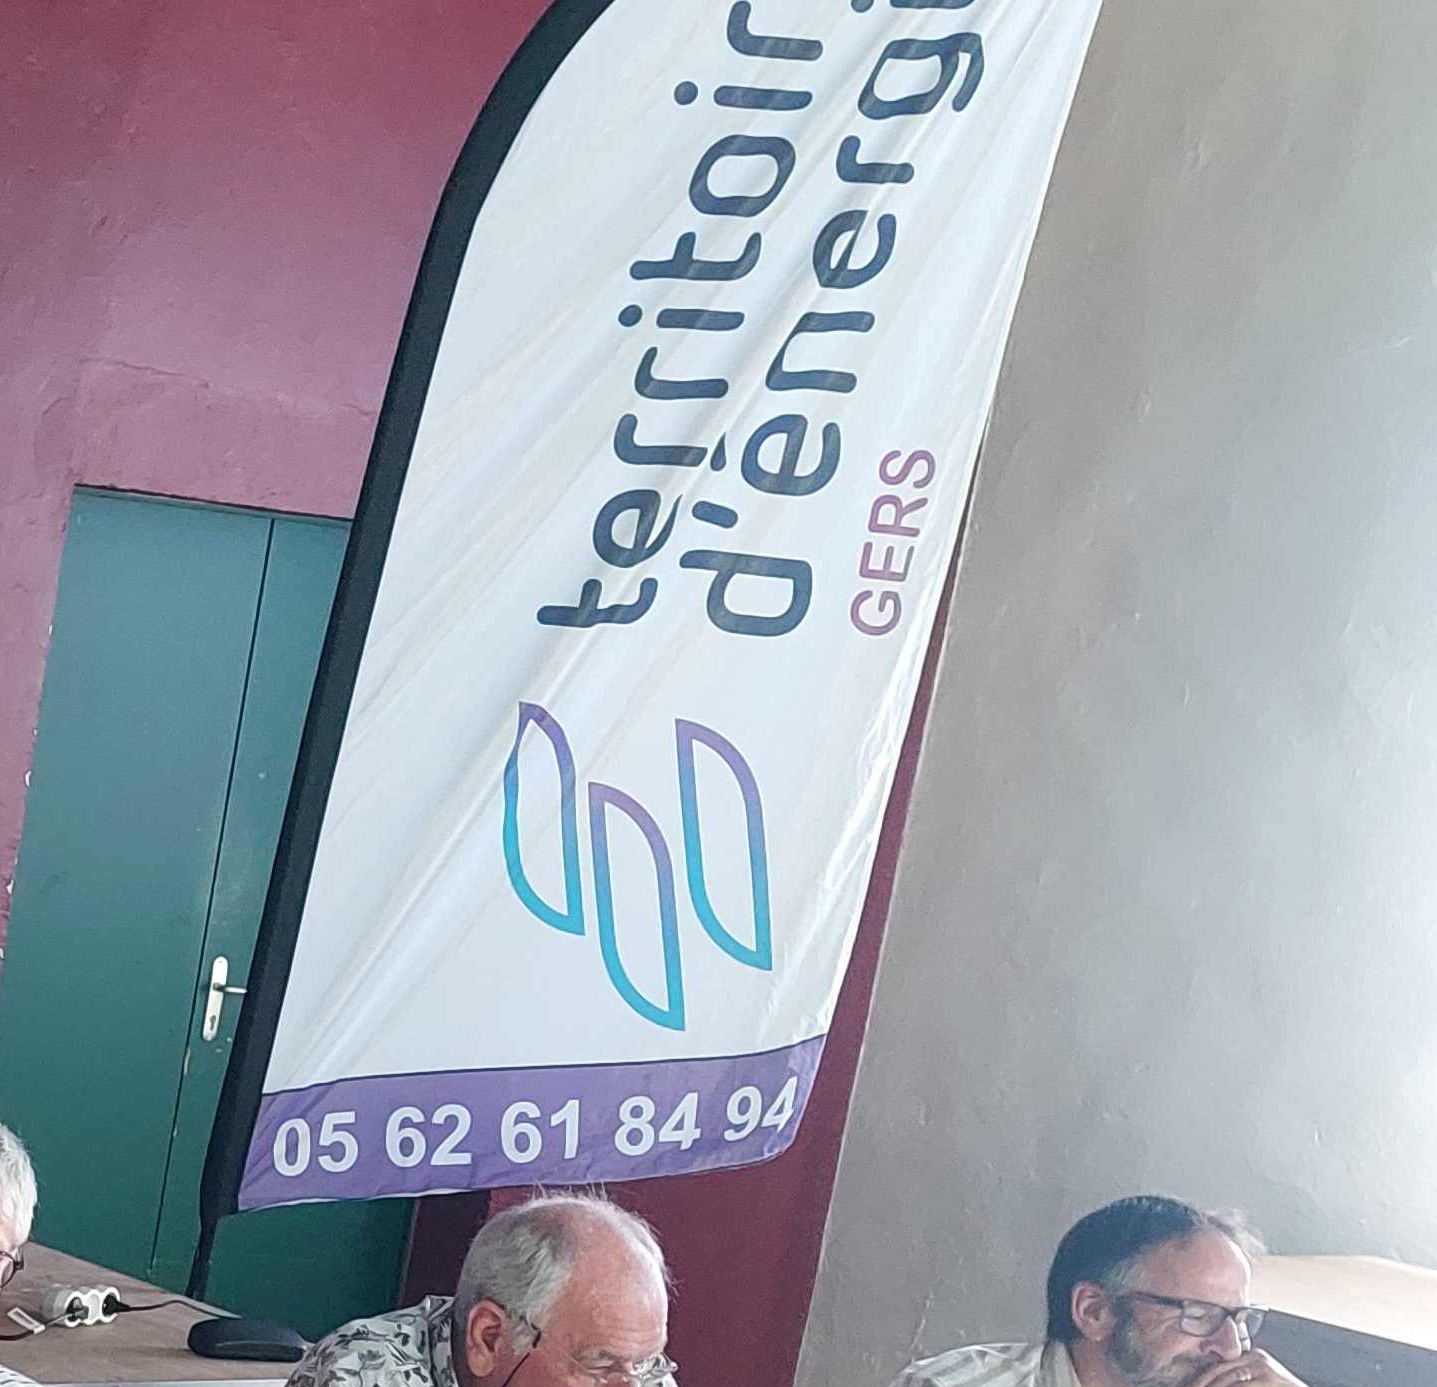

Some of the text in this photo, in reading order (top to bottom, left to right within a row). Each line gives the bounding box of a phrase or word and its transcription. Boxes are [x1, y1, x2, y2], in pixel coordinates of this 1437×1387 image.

[850, 450, 936, 636] GERS
[273, 1076, 799, 1177] 05 62 61 84 94
